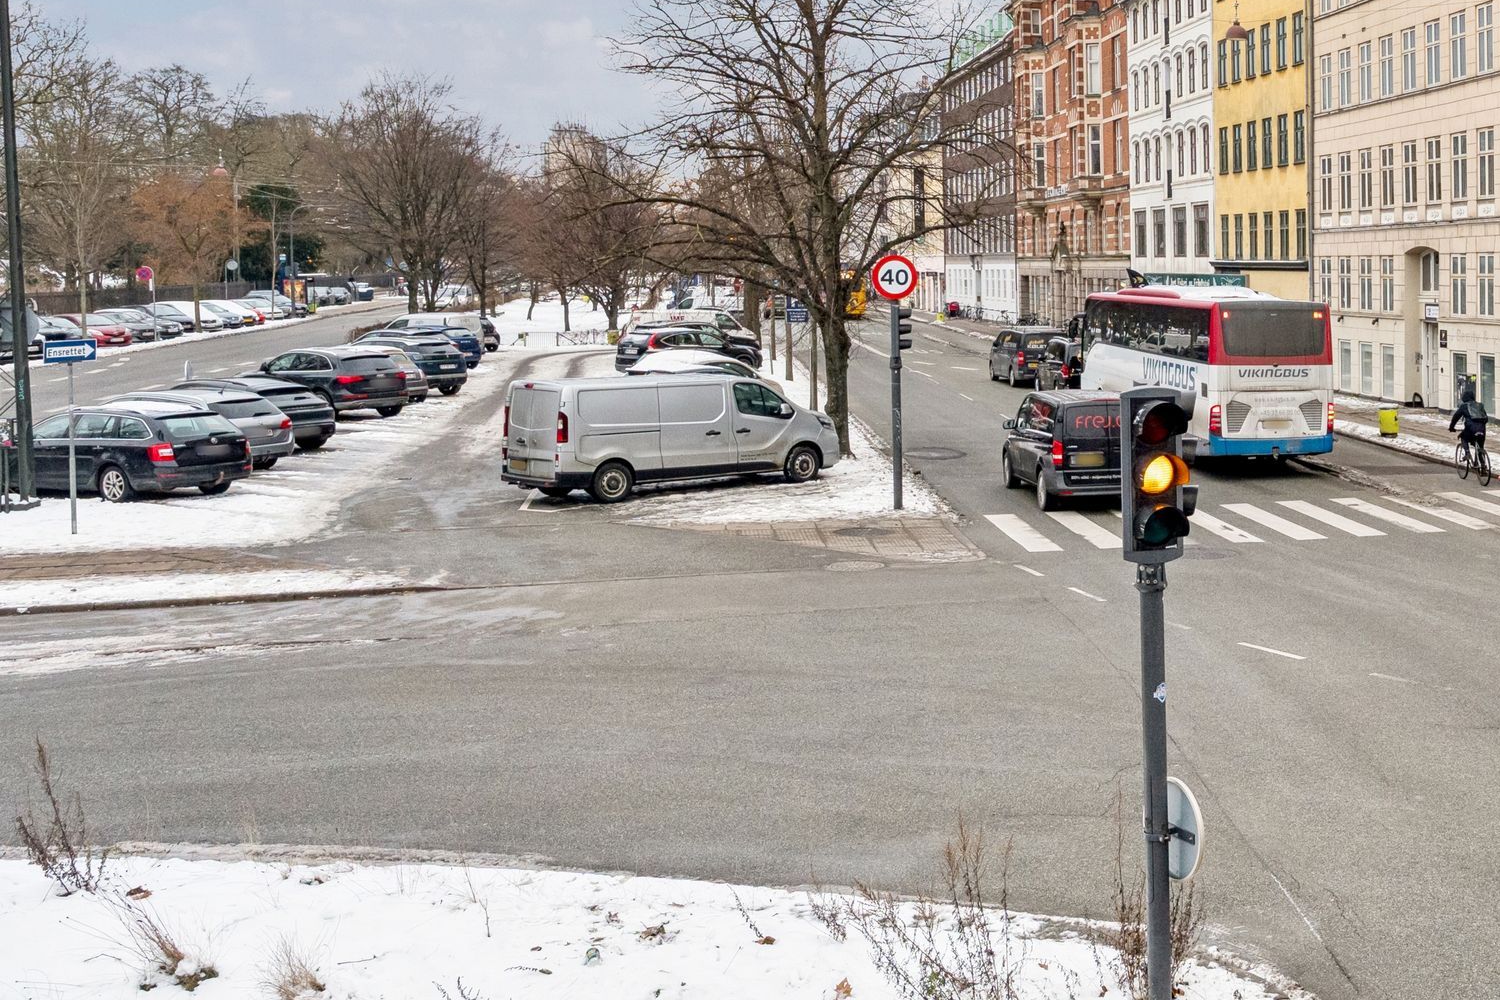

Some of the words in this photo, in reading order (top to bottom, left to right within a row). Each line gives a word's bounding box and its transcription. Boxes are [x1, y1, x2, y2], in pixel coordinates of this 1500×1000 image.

[881, 269, 909, 285] 40
[48, 347, 86, 357] Ensrettet
[1143, 357, 1196, 391] VIKINGBUS
[1238, 368, 1309, 378] VIKINGBUS
